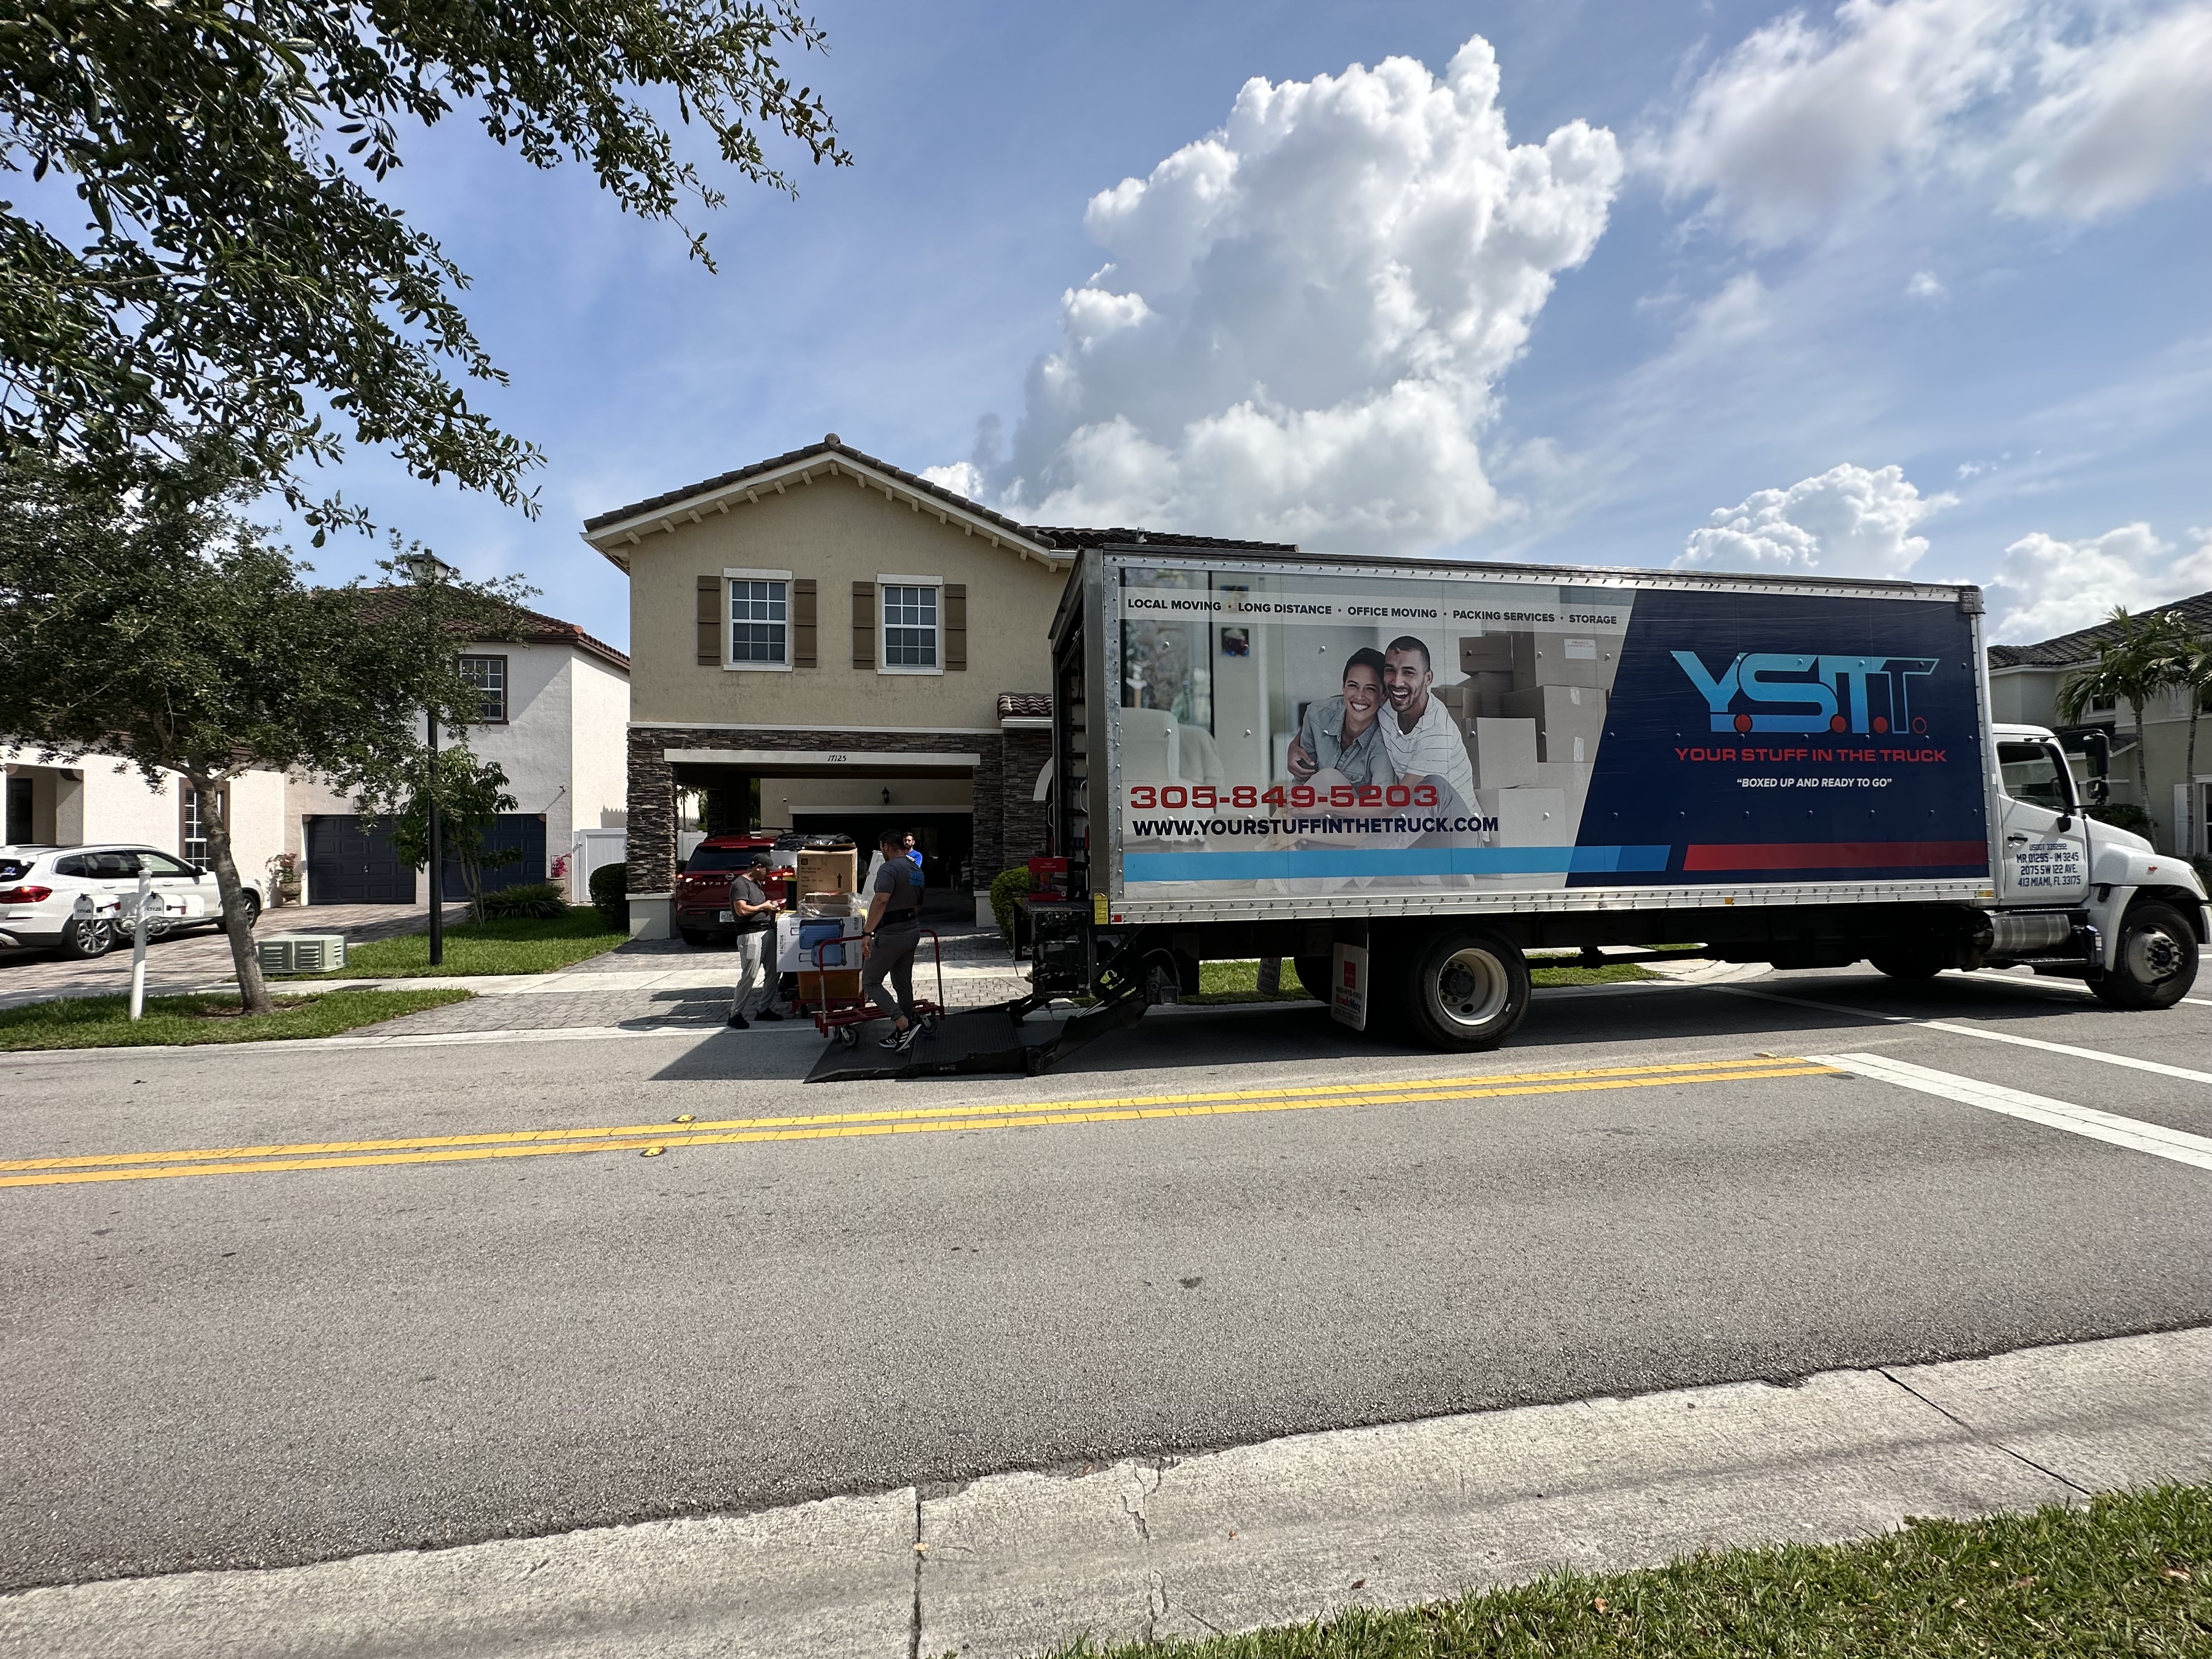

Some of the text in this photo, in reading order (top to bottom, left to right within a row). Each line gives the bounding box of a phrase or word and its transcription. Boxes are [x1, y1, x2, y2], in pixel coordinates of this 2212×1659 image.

[1128, 599, 1617, 624] LOCAL MOVING LONG DISTANCE OFFICE MOVING PACKING SERVICES STORAGE
[1674, 748, 1947, 762] YOUR STUFF IN THE TRUCK
[1780, 778, 1795, 787] UP
[1796, 778, 1819, 787] AND
[1821, 778, 1855, 787] READY
[1857, 778, 1870, 787] TO
[1130, 785, 1438, 809] 305-849-5203
[1132, 816, 1499, 836] WWW.YOURSTUFFINTHETRUCK.COM
[2016, 854, 2027, 863] MR
[2063, 852, 2079, 861] 3245
[2021, 865, 2039, 875] 2075
[2040, 865, 2051, 874] SW
[2052, 864, 2063, 874] 122
[2018, 877, 2029, 887] 413
[2053, 876, 2061, 885] FL
[2062, 875, 2080, 885] 33175
